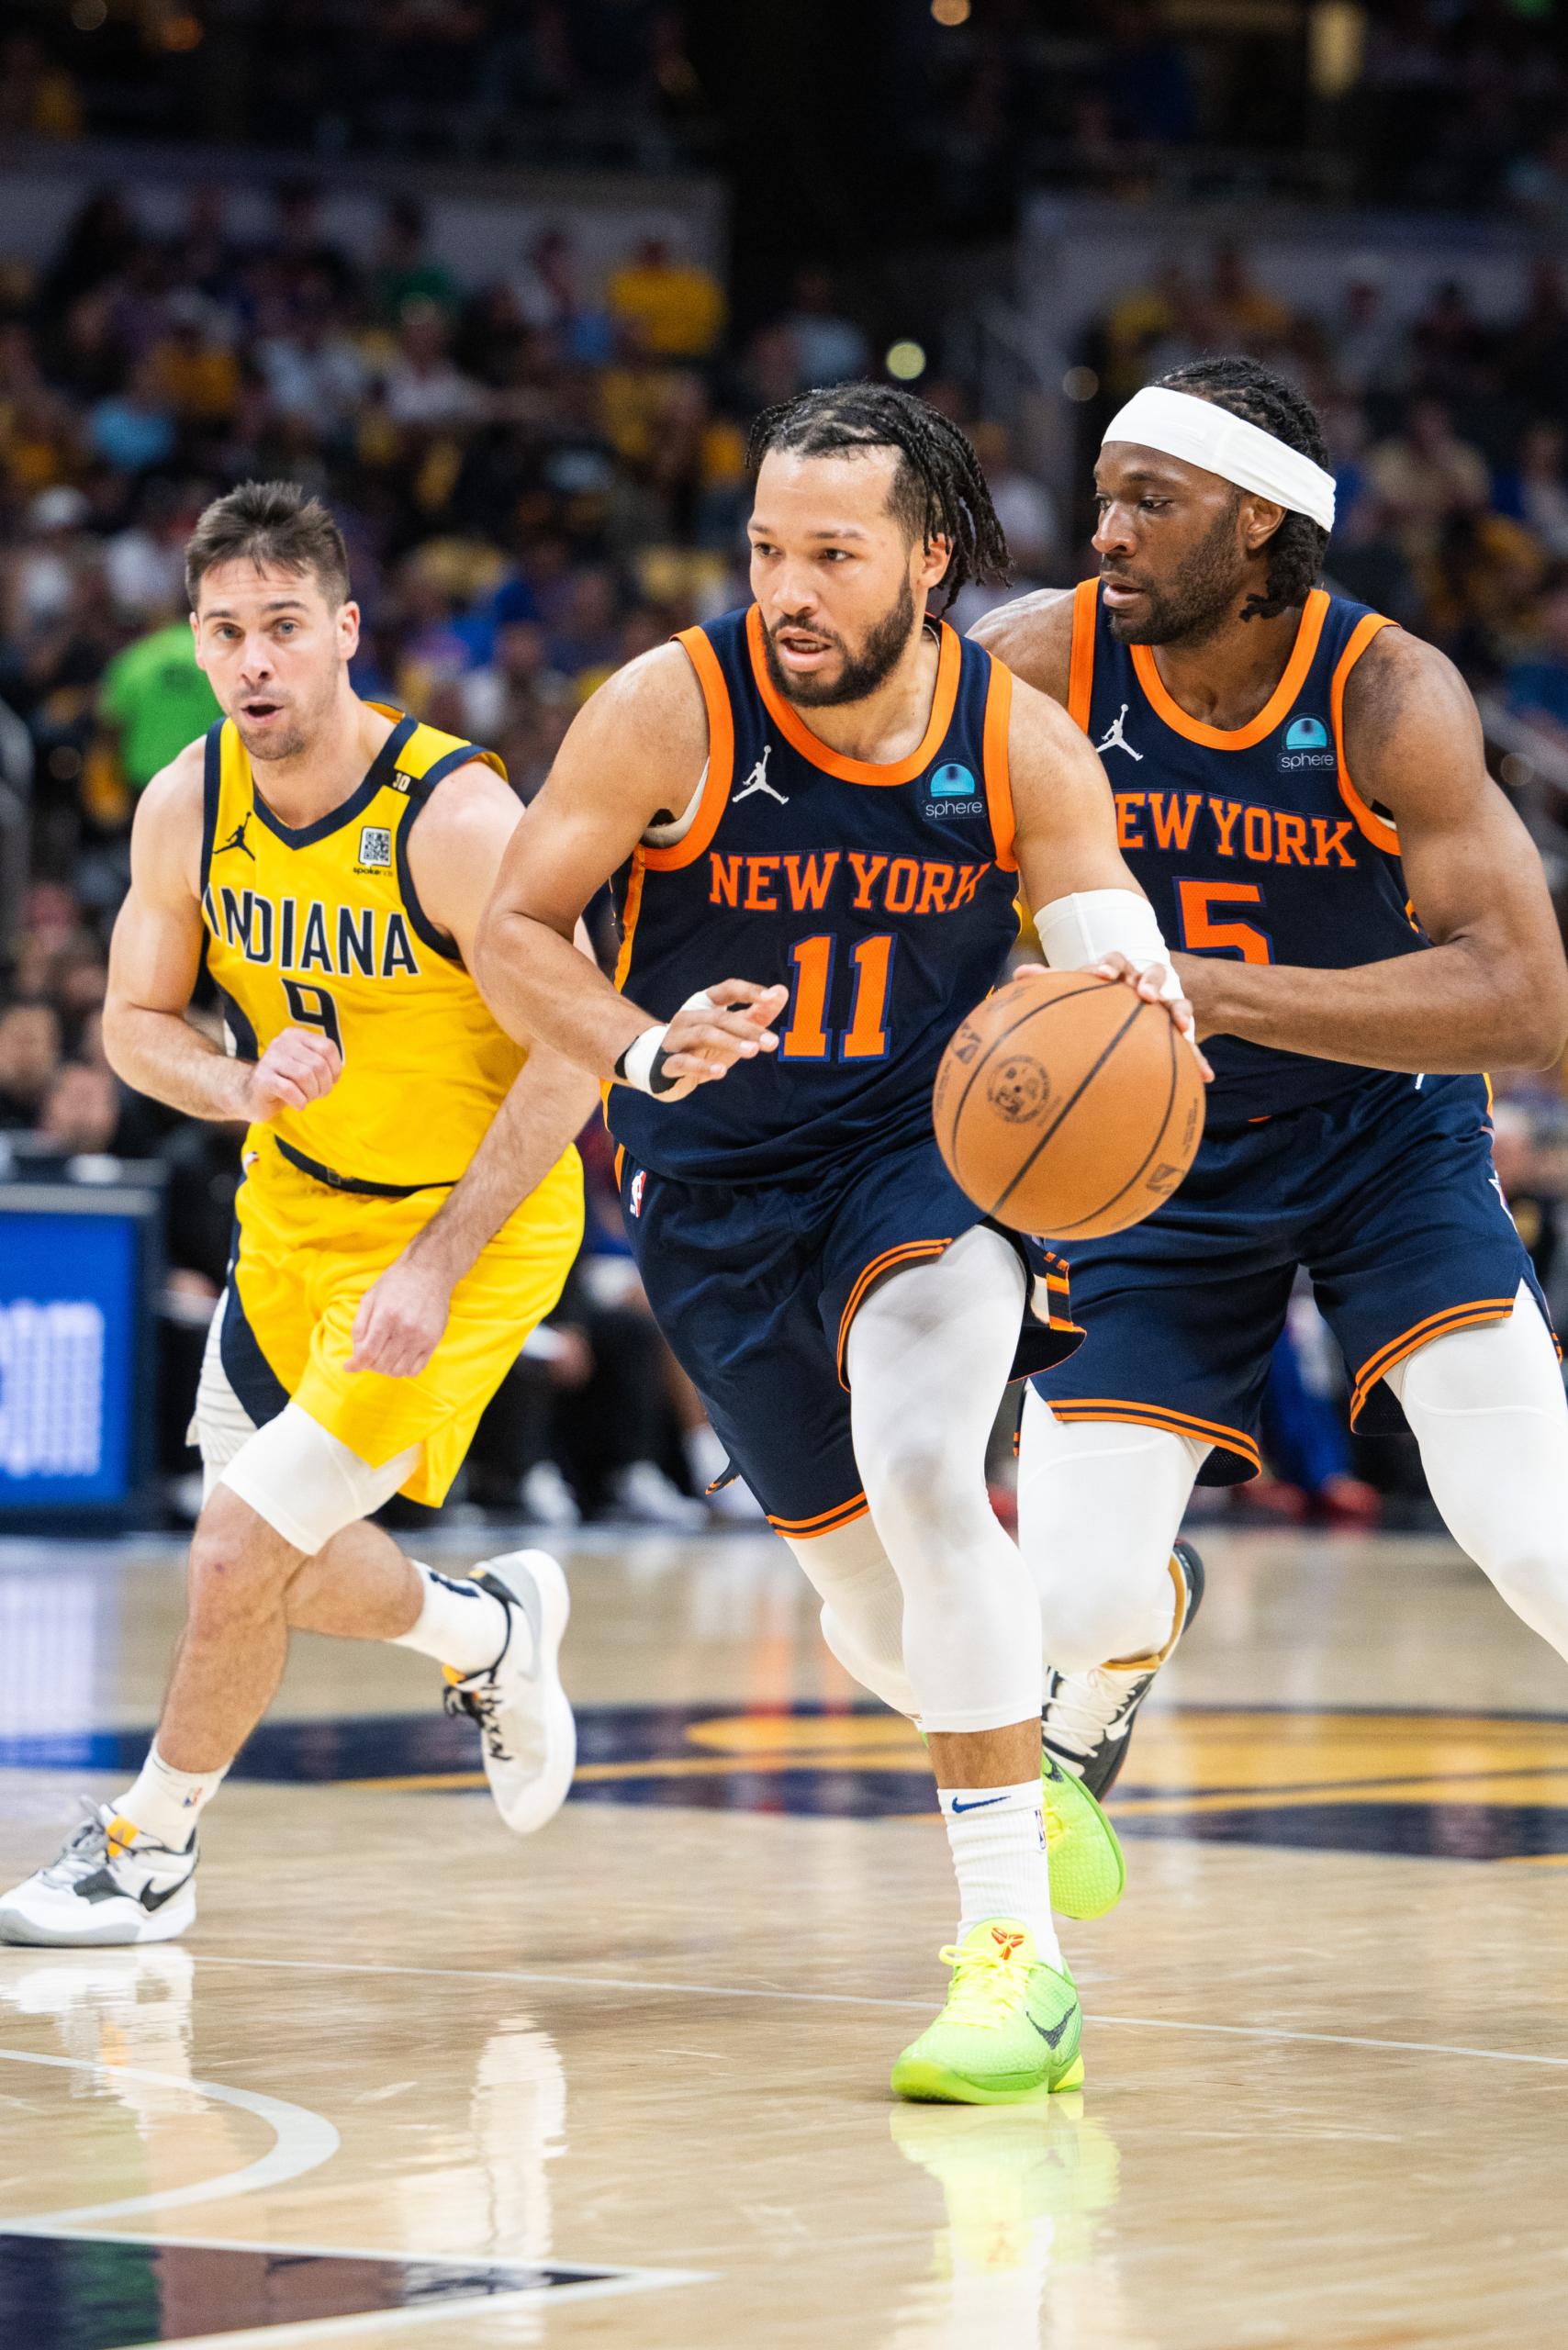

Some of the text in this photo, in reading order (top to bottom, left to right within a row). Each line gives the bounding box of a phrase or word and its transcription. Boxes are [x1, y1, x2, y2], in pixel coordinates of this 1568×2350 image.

[1281, 753, 1334, 770] sphere
[925, 800, 982, 819] sphere
[1114, 792, 1358, 867] EW YORK
[709, 852, 991, 914] NEW YORK
[1172, 878, 1274, 965] 5
[202, 883, 420, 978] INDIANA
[280, 977, 344, 1065] 9
[778, 933, 898, 1063] 11
